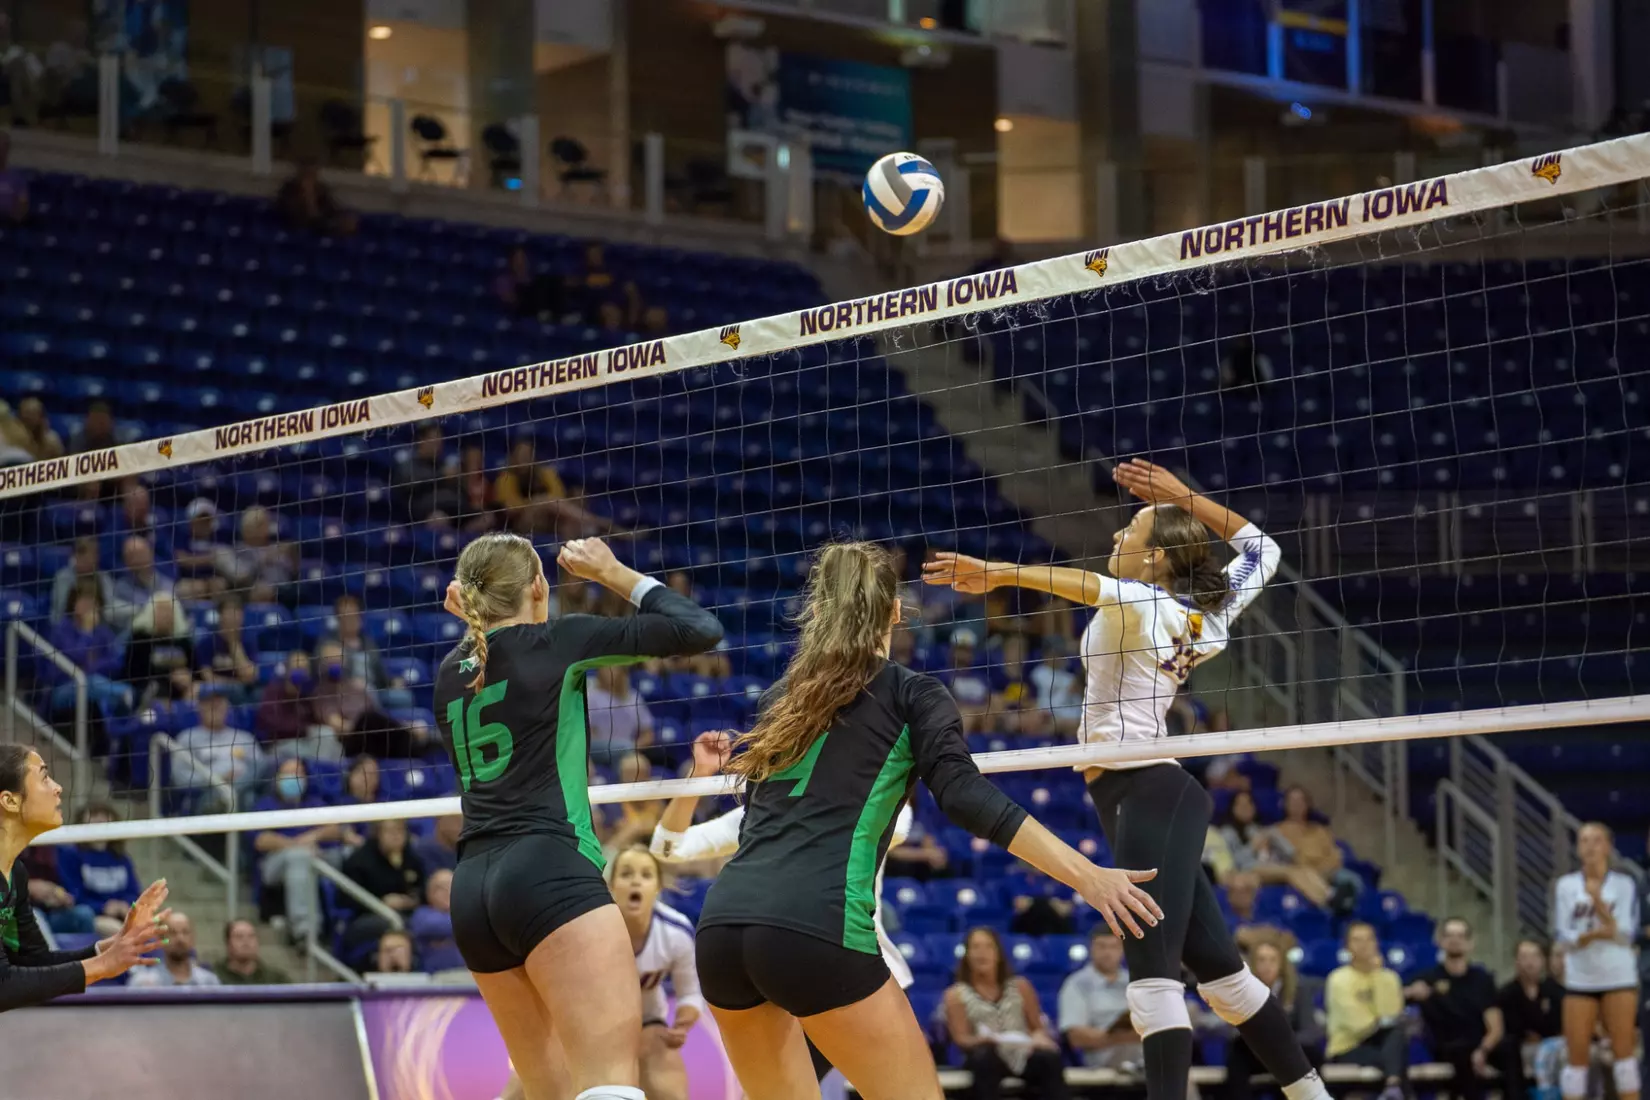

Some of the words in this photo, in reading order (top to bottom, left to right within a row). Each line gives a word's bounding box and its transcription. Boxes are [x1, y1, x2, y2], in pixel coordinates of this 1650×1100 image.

[1531, 152, 1562, 174] UNI
[1180, 200, 1349, 260] NORTHERN
[1363, 178, 1449, 222] IOWA
[1084, 248, 1110, 266] UNI
[800, 284, 938, 336] NORTHERN
[947, 268, 1018, 307] IOWA
[482, 353, 599, 398] NORTHERN
[607, 340, 666, 373] IOWA
[215, 411, 314, 450] NORTHERN
[320, 399, 371, 430] IOWA
[75, 450, 119, 477] IOWA
[446, 679, 513, 793] 16
